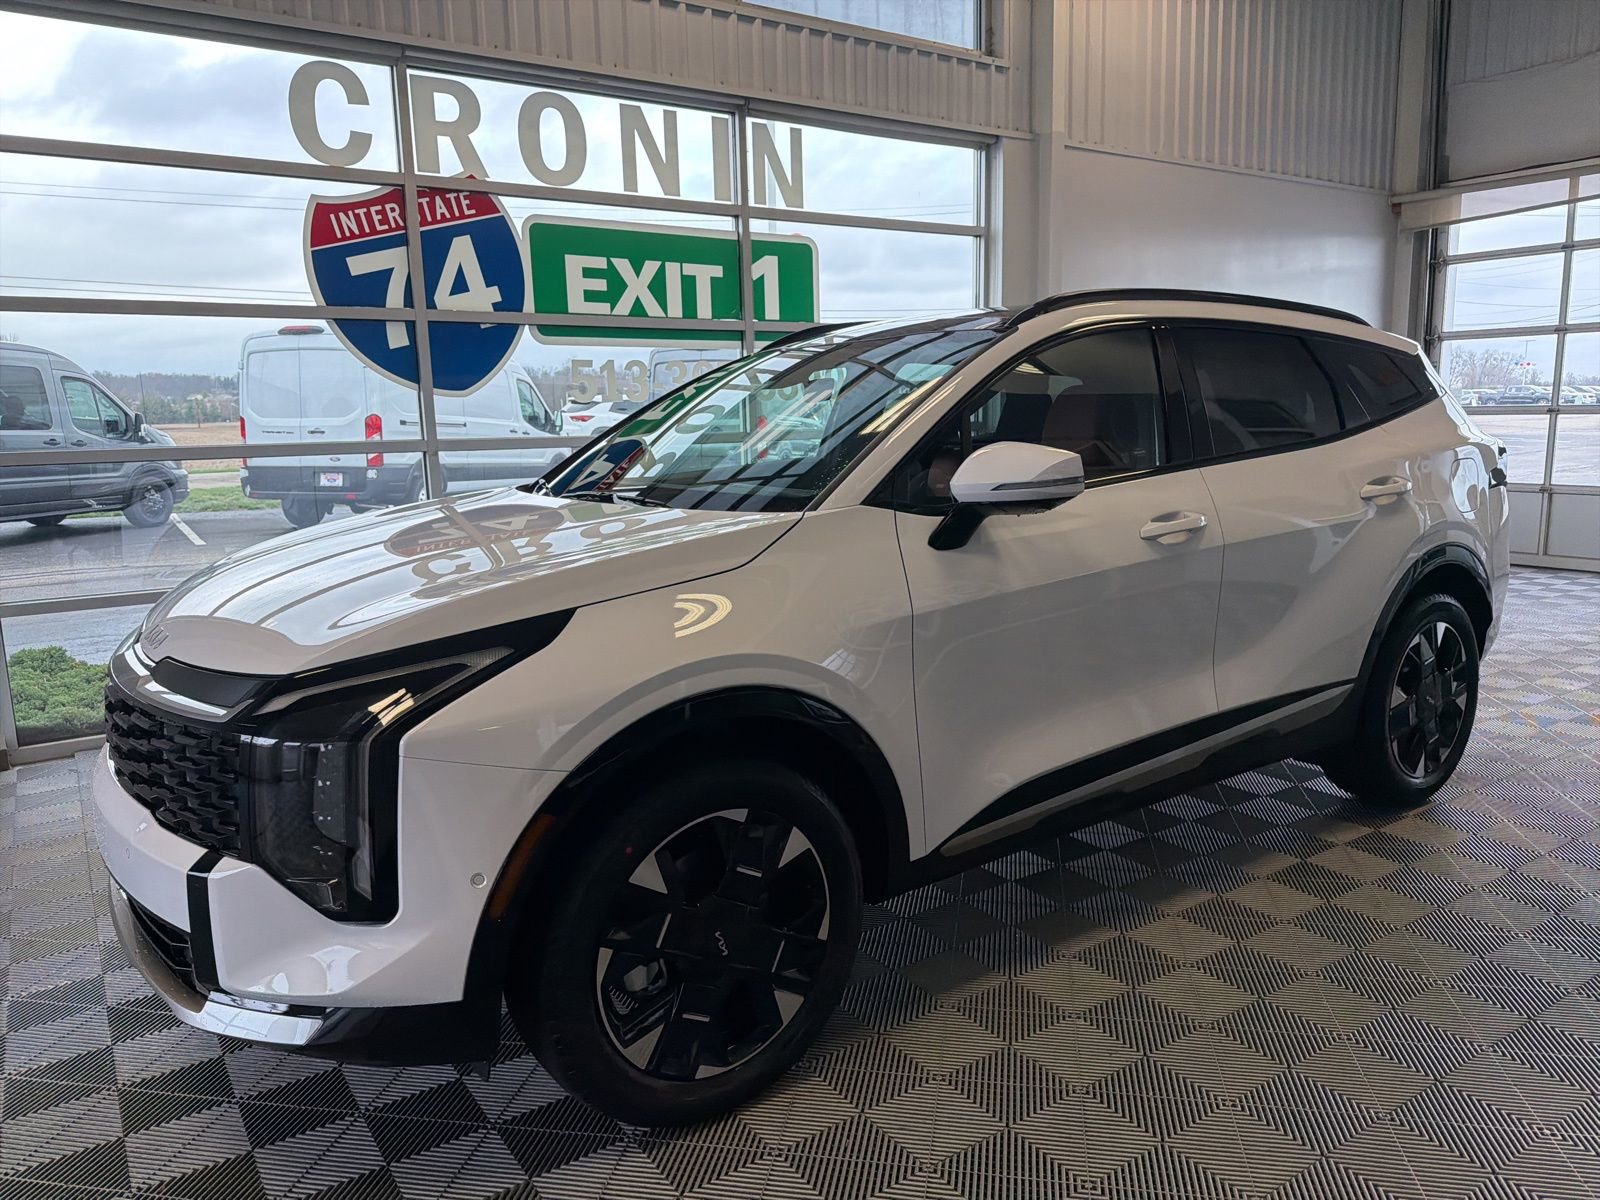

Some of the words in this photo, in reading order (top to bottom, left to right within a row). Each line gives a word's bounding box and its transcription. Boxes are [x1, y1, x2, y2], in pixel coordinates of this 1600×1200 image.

[288, 60, 804, 209] CRONIN
[329, 191, 477, 239] INTERTATE
[345, 234, 503, 350] 74
[564, 253, 724, 320] EXIT
[751, 254, 780, 320] 1
